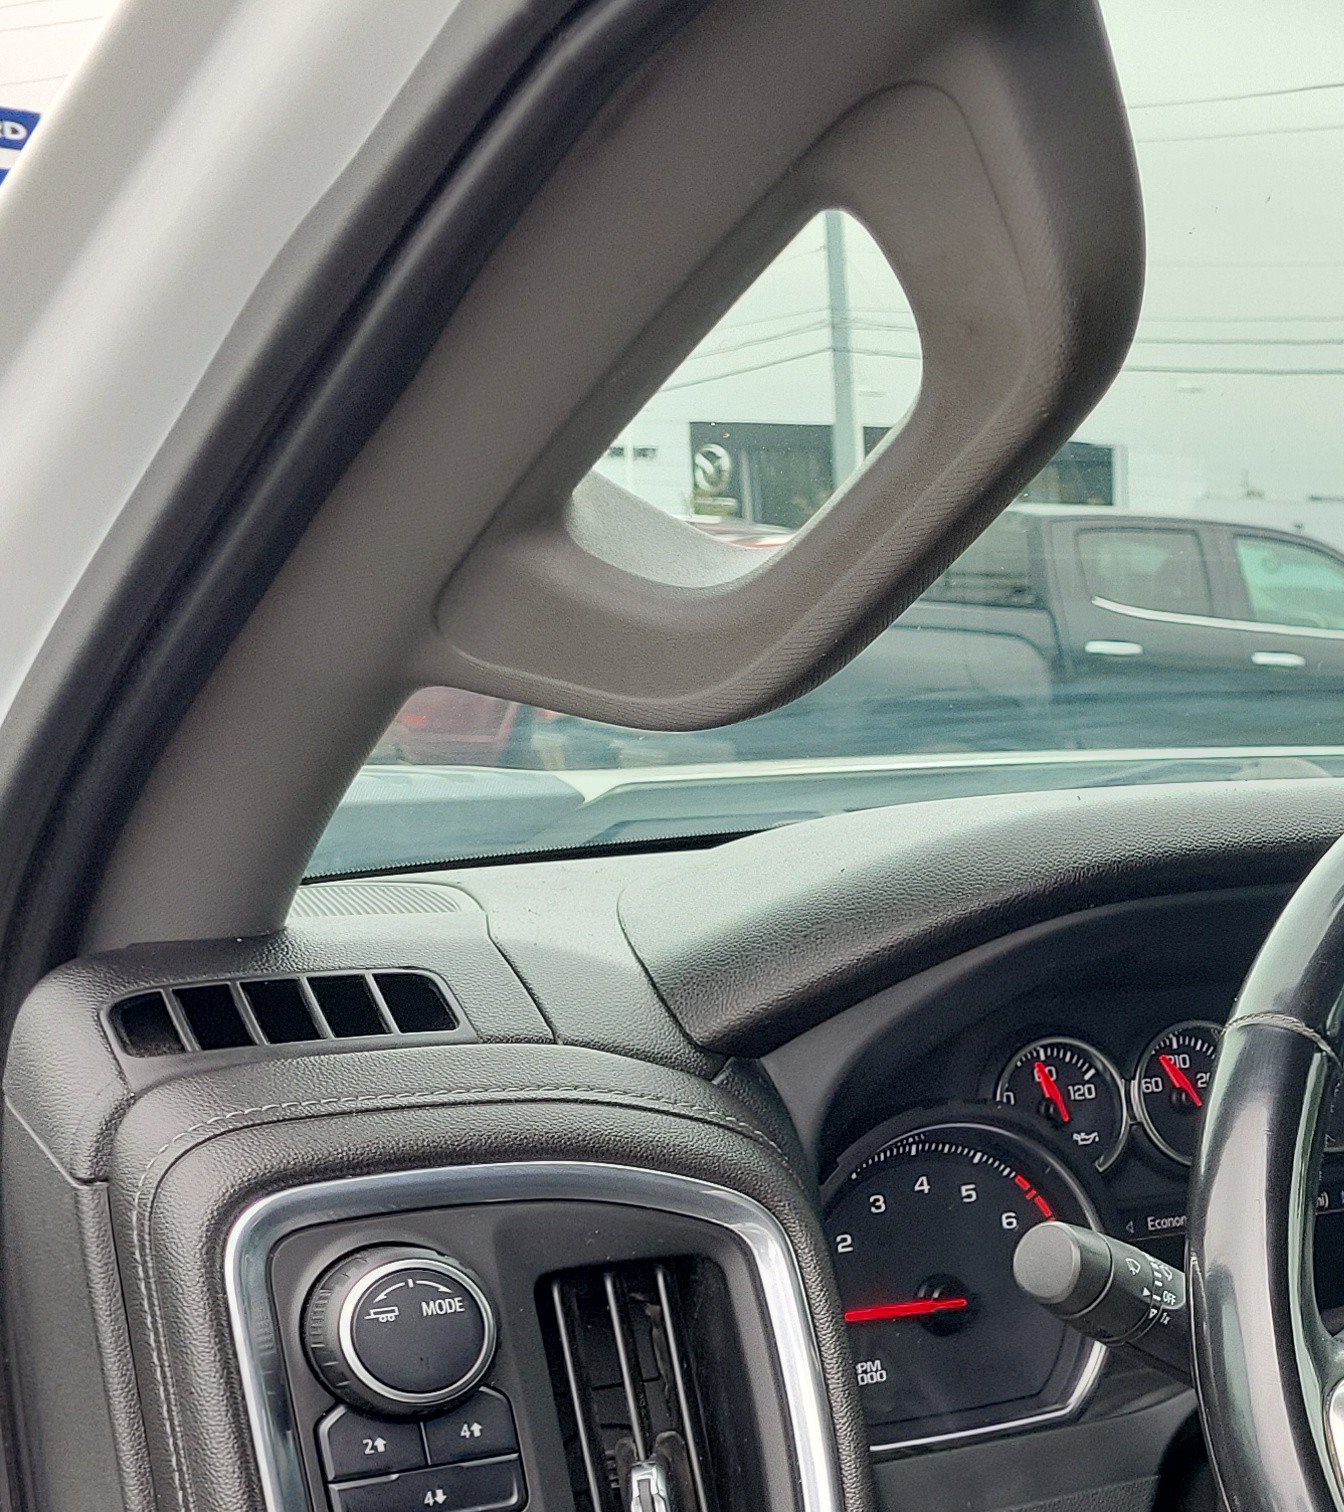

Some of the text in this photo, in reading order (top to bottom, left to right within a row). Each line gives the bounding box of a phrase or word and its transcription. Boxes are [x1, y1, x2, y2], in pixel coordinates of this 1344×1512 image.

[1068, 1084, 1096, 1101] 120
[914, 1176, 930, 1194] 4
[960, 1184, 977, 1202] 5
[869, 1195, 886, 1213] 3
[1001, 1212, 1017, 1230] 6
[836, 1234, 853, 1252] 2
[1162, 1290, 1177, 1306] OFF
[422, 1297, 466, 1318] MODE
